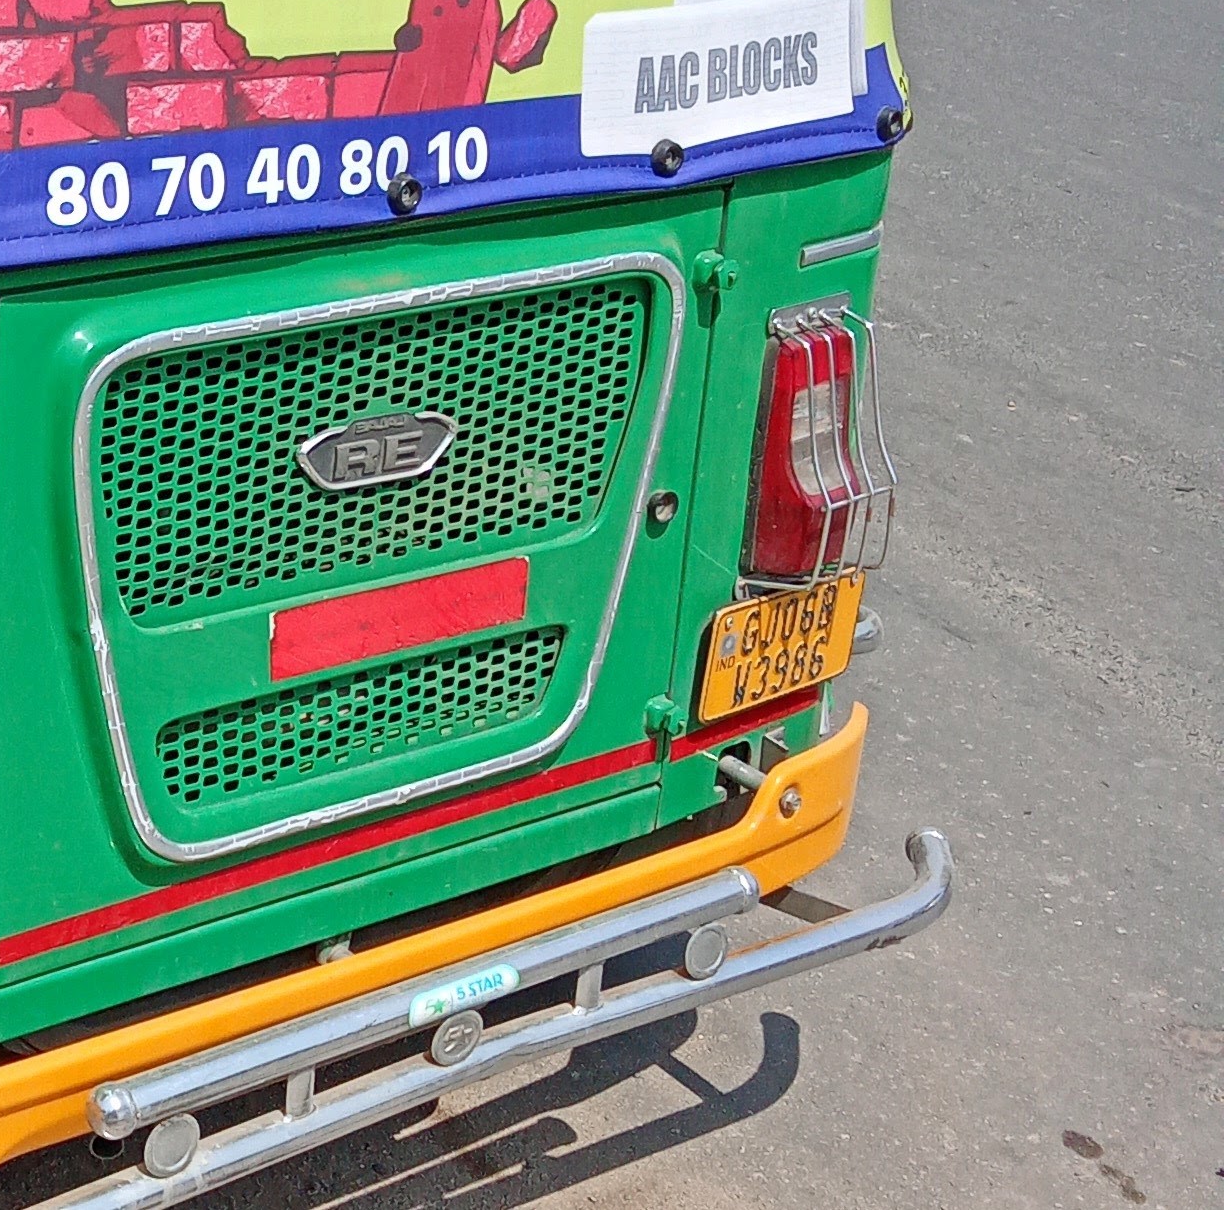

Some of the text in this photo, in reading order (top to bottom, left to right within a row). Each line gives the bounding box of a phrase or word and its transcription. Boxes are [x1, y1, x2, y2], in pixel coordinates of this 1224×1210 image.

[634, 51, 700, 114] AAC
[707, 31, 818, 103] BLOCKS
[45, 126, 489, 227] 80 70 40 80 10
[456, 973, 503, 1001] 5 STAR
